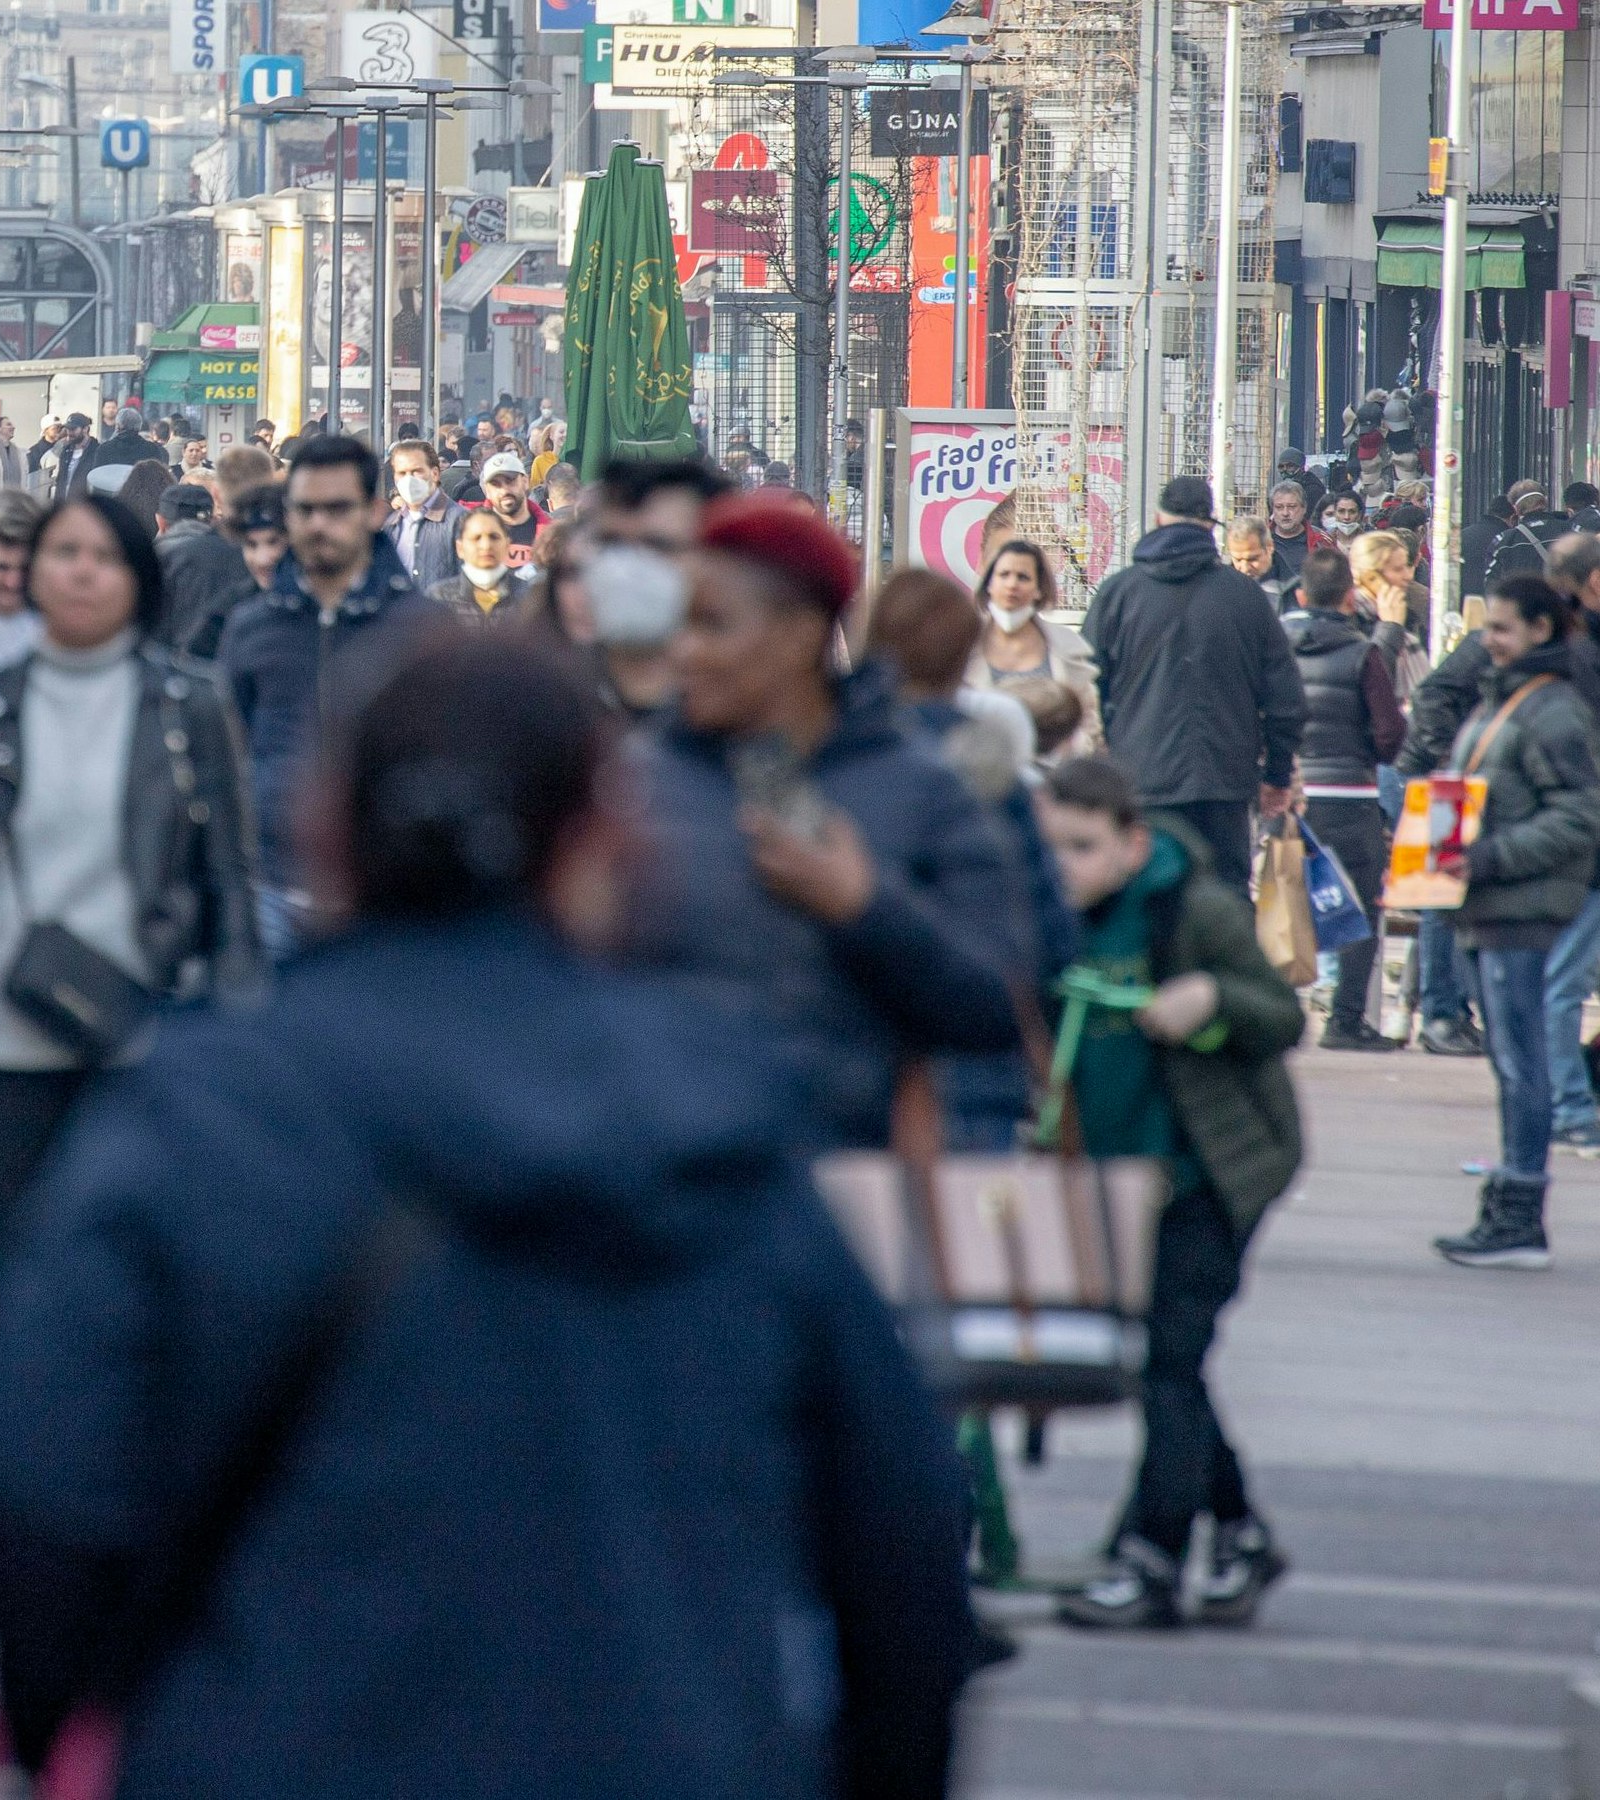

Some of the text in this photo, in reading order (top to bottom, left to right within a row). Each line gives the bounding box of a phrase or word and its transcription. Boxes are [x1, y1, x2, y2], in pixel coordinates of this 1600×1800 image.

[253, 69, 293, 104] U
[656, 69, 681, 77] DIE
[888, 109, 960, 129] GÜNA
[109, 129, 141, 162] U
[201, 362, 236, 375] HOT
[938, 439, 985, 467] fad
[921, 466, 975, 496] fru
